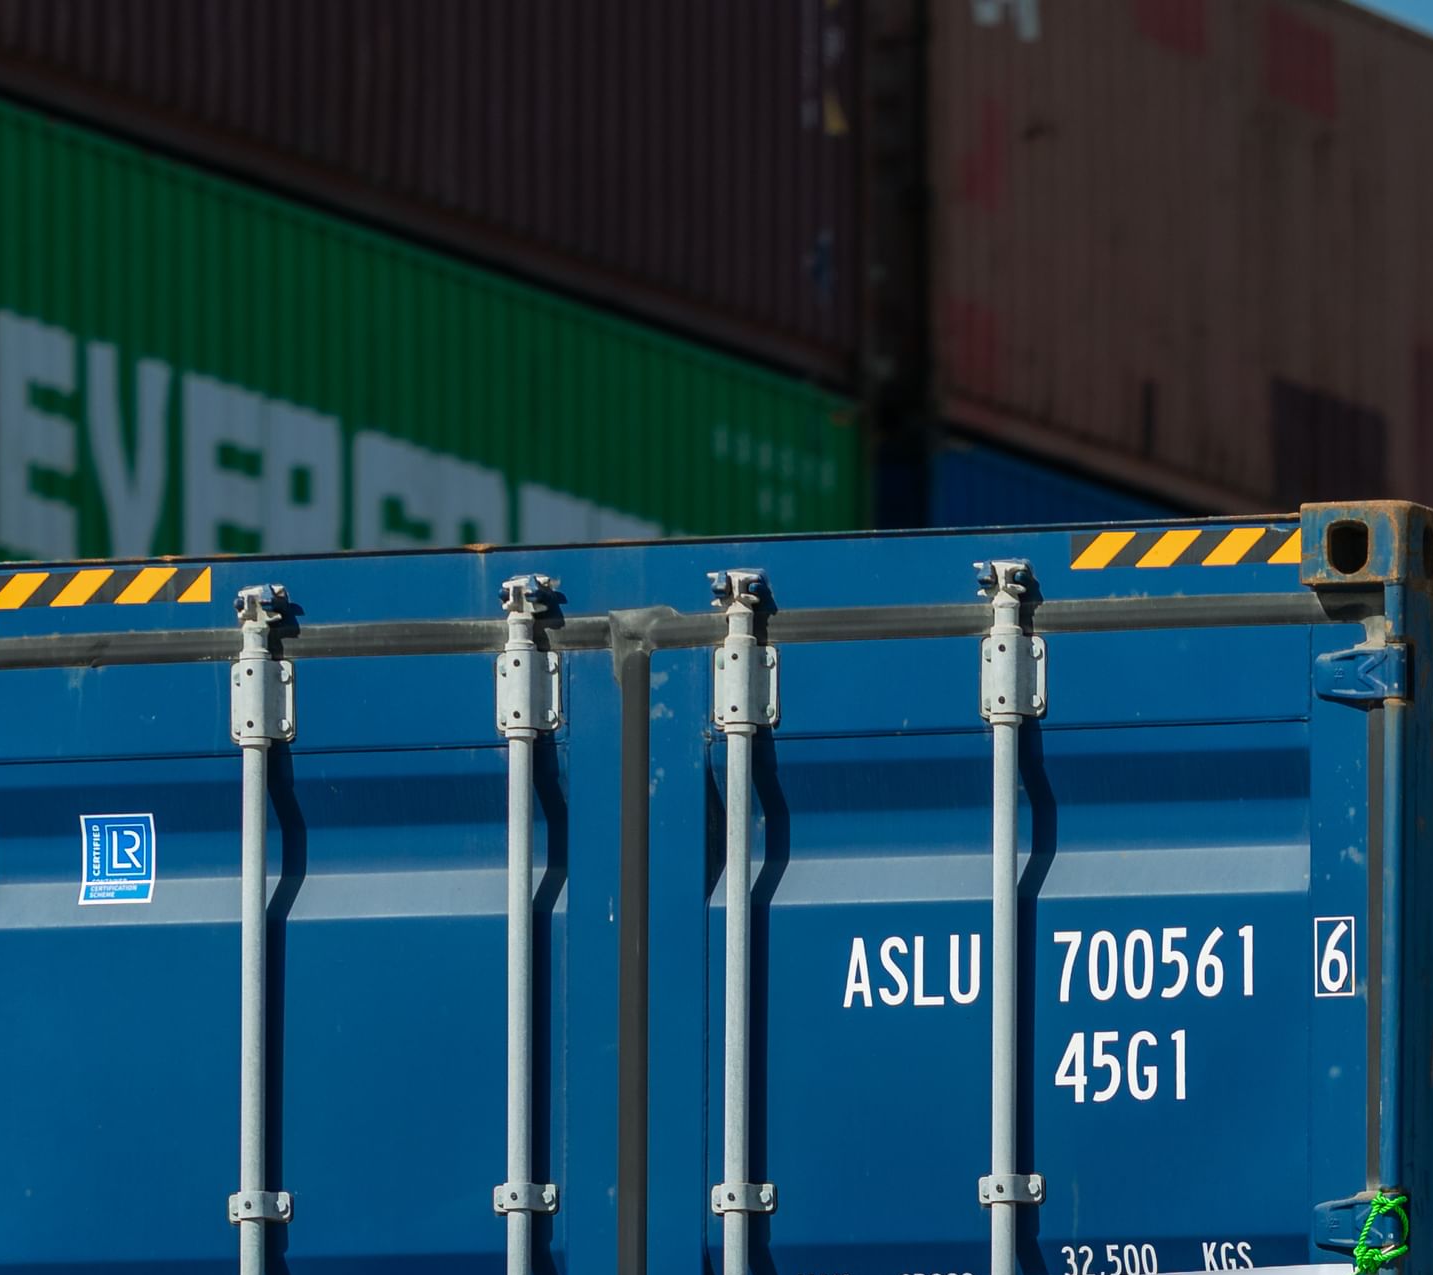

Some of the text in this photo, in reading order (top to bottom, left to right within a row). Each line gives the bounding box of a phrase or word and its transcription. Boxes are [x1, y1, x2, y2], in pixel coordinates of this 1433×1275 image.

[92, 825, 101, 876] CERTIFIED
[112, 830, 142, 868] LR
[843, 921, 1349, 1008] ASLU 700561 6
[1054, 1029, 1186, 1103] 45G1
[1202, 1241, 1254, 1272] KGS
